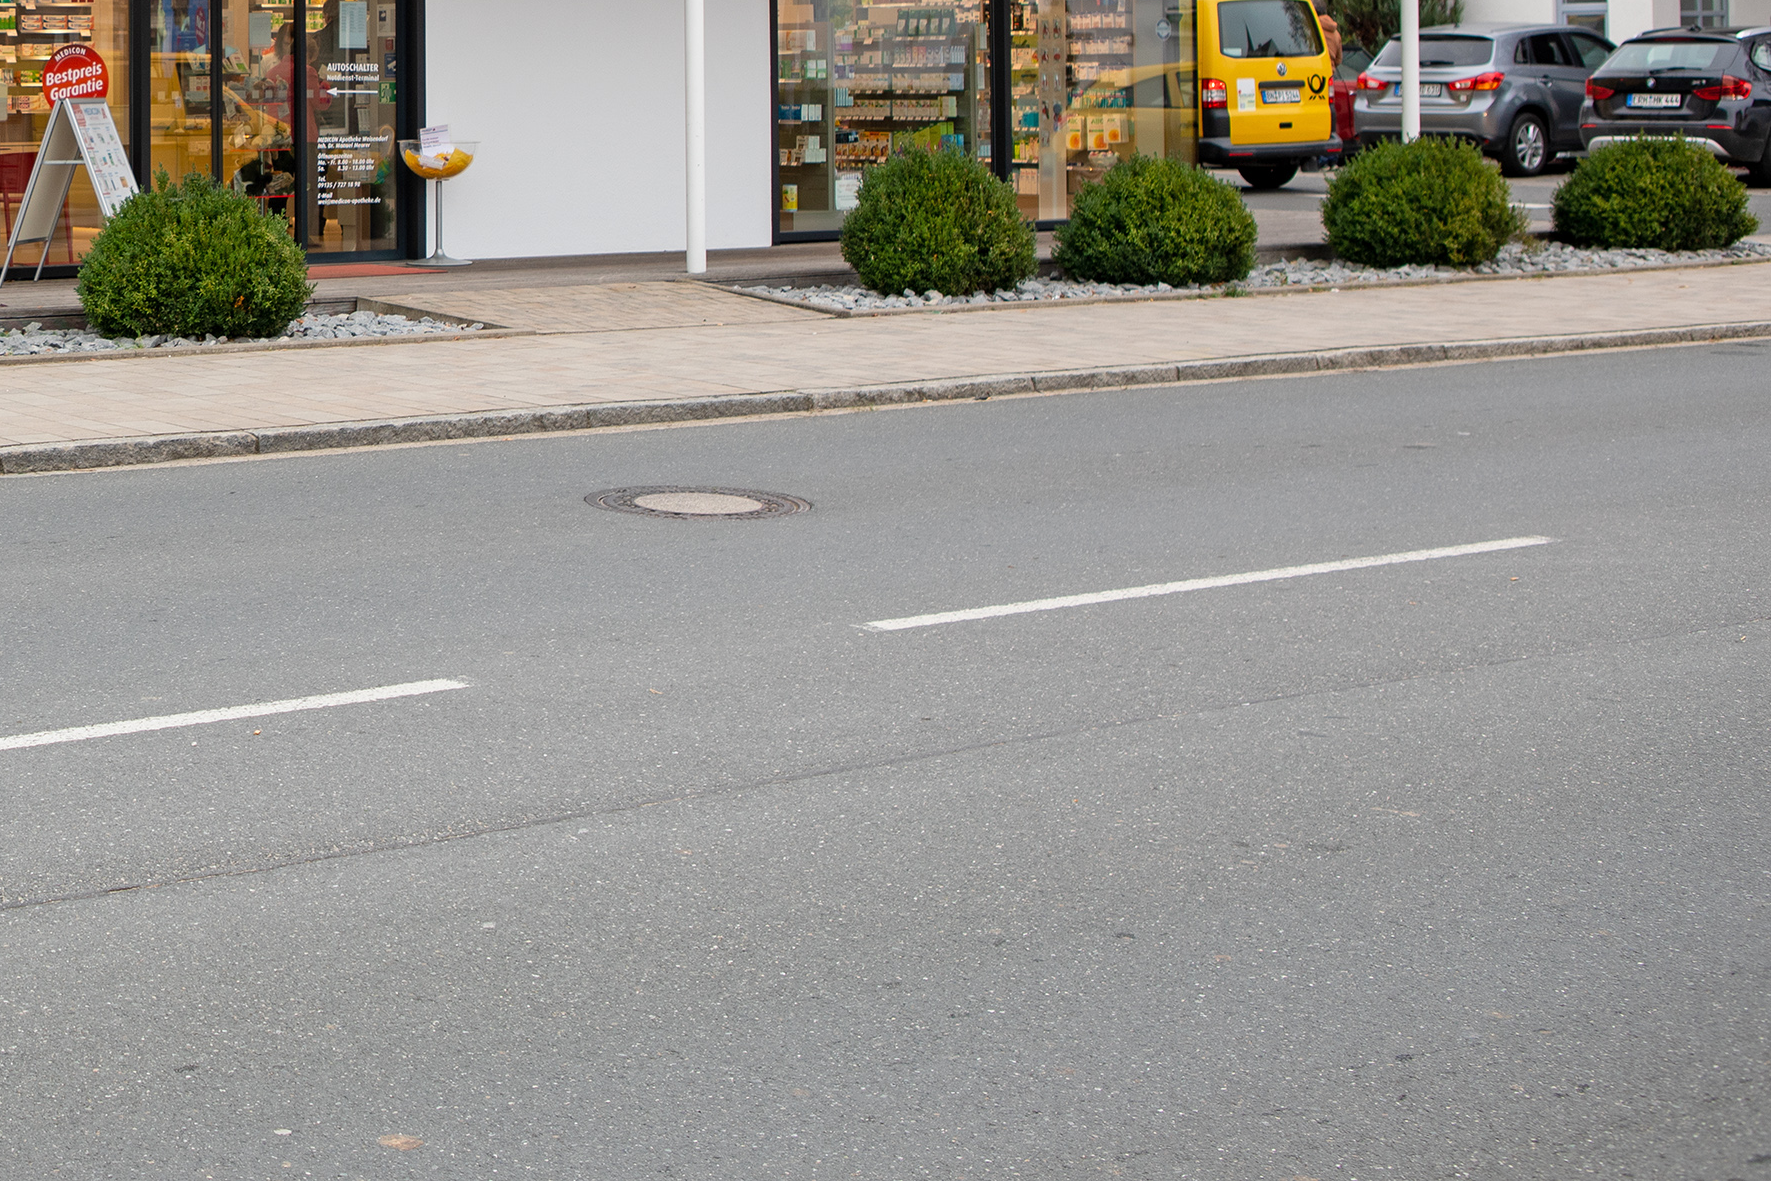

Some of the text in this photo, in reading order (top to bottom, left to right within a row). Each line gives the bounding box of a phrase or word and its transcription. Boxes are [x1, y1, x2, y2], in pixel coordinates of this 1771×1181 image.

[54, 46, 87, 62] MEDICON
[45, 62, 103, 87] Bestpreis
[326, 62, 379, 72] AUTOSCHALTER
[326, 74, 380, 82] Notdienst-Terminal
[50, 78, 104, 101] Garantie
